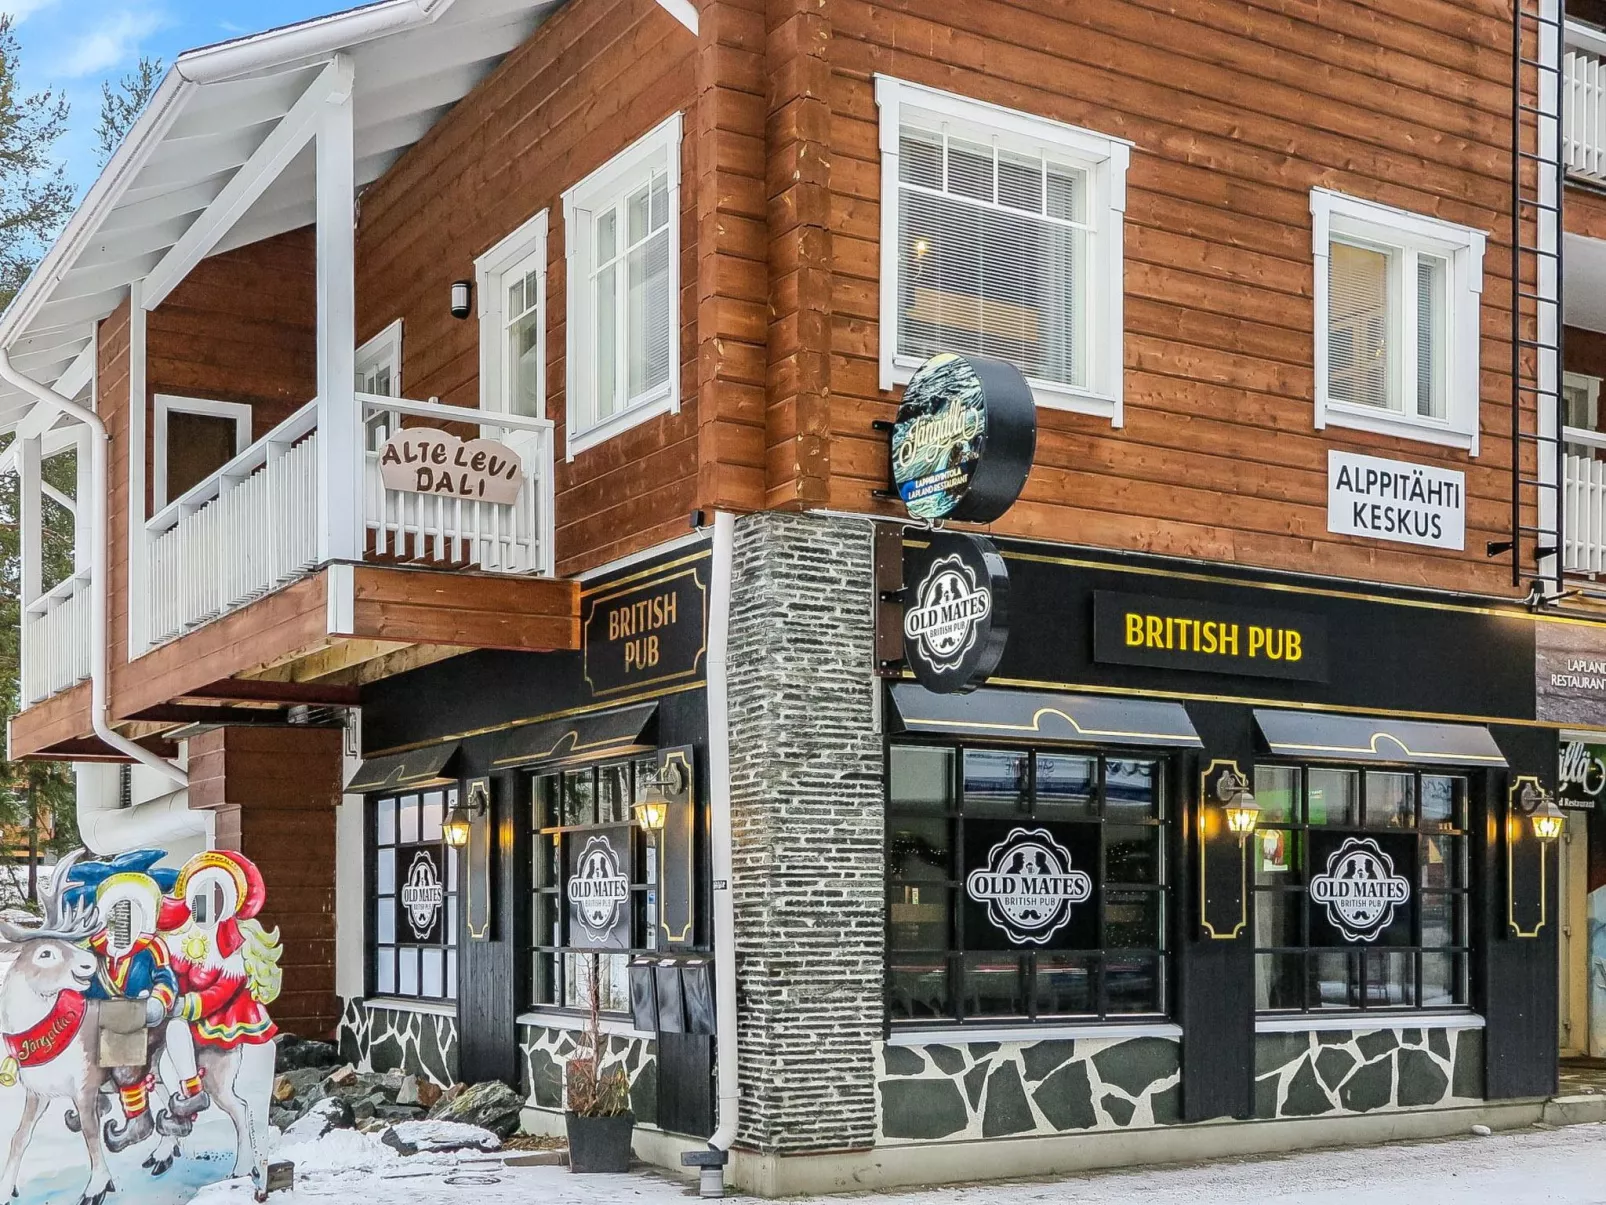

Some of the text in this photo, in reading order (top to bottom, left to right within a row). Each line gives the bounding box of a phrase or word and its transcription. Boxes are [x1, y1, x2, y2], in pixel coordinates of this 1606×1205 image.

[382, 441, 448, 466] ALTE
[416, 466, 486, 498] DALI
[933, 474, 970, 493] RESTAURANT
[1335, 464, 1460, 509] ALPPITÄHTI
[1353, 501, 1442, 540] KESKUS
[609, 591, 677, 641] BRITISH
[910, 593, 986, 633] OLD MATES
[929, 620, 966, 638] BRITISH PUB
[1126, 613, 1303, 662] BRITISH PUB
[624, 635, 660, 673] PUB
[1564, 797, 1595, 808] Restaurant
[404, 887, 442, 902] OLD MATES
[571, 880, 626, 898] OLD MATES
[974, 876, 1085, 895] OLD MATES
[1316, 881, 1405, 898] OLD MATES
[1004, 896, 1056, 906] BRITISH PUB
[1340, 899, 1381, 908] BRITISH PUB
